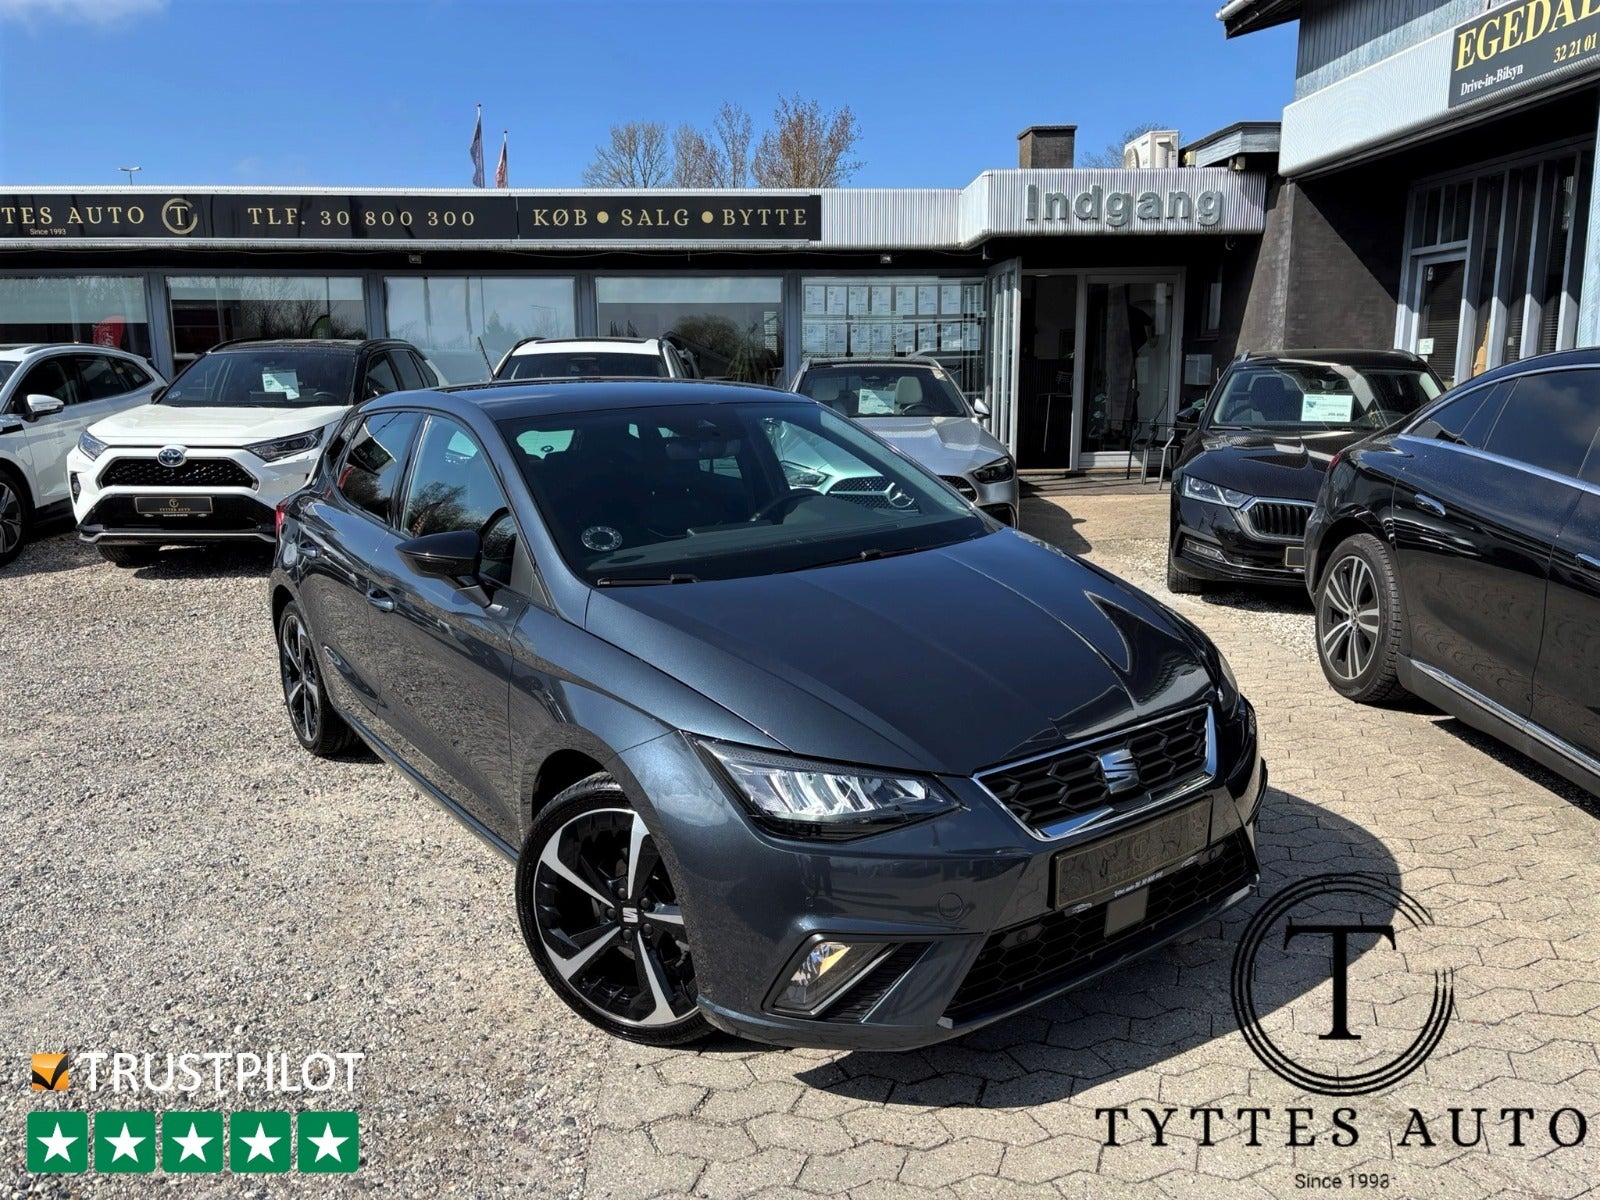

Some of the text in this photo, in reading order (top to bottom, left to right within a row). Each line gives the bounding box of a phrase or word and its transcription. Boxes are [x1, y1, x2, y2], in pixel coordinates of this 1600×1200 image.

[1553, 32, 1597, 63] 32 21 01
[1460, 63, 1524, 96] Drive-in-Bilsyn
[67, 206, 145, 224] AUTO
[247, 207, 475, 226] TLF. 30 800 300
[533, 208, 807, 227] KØB SALG BYTTE
[1025, 184, 1223, 226] Indgang
